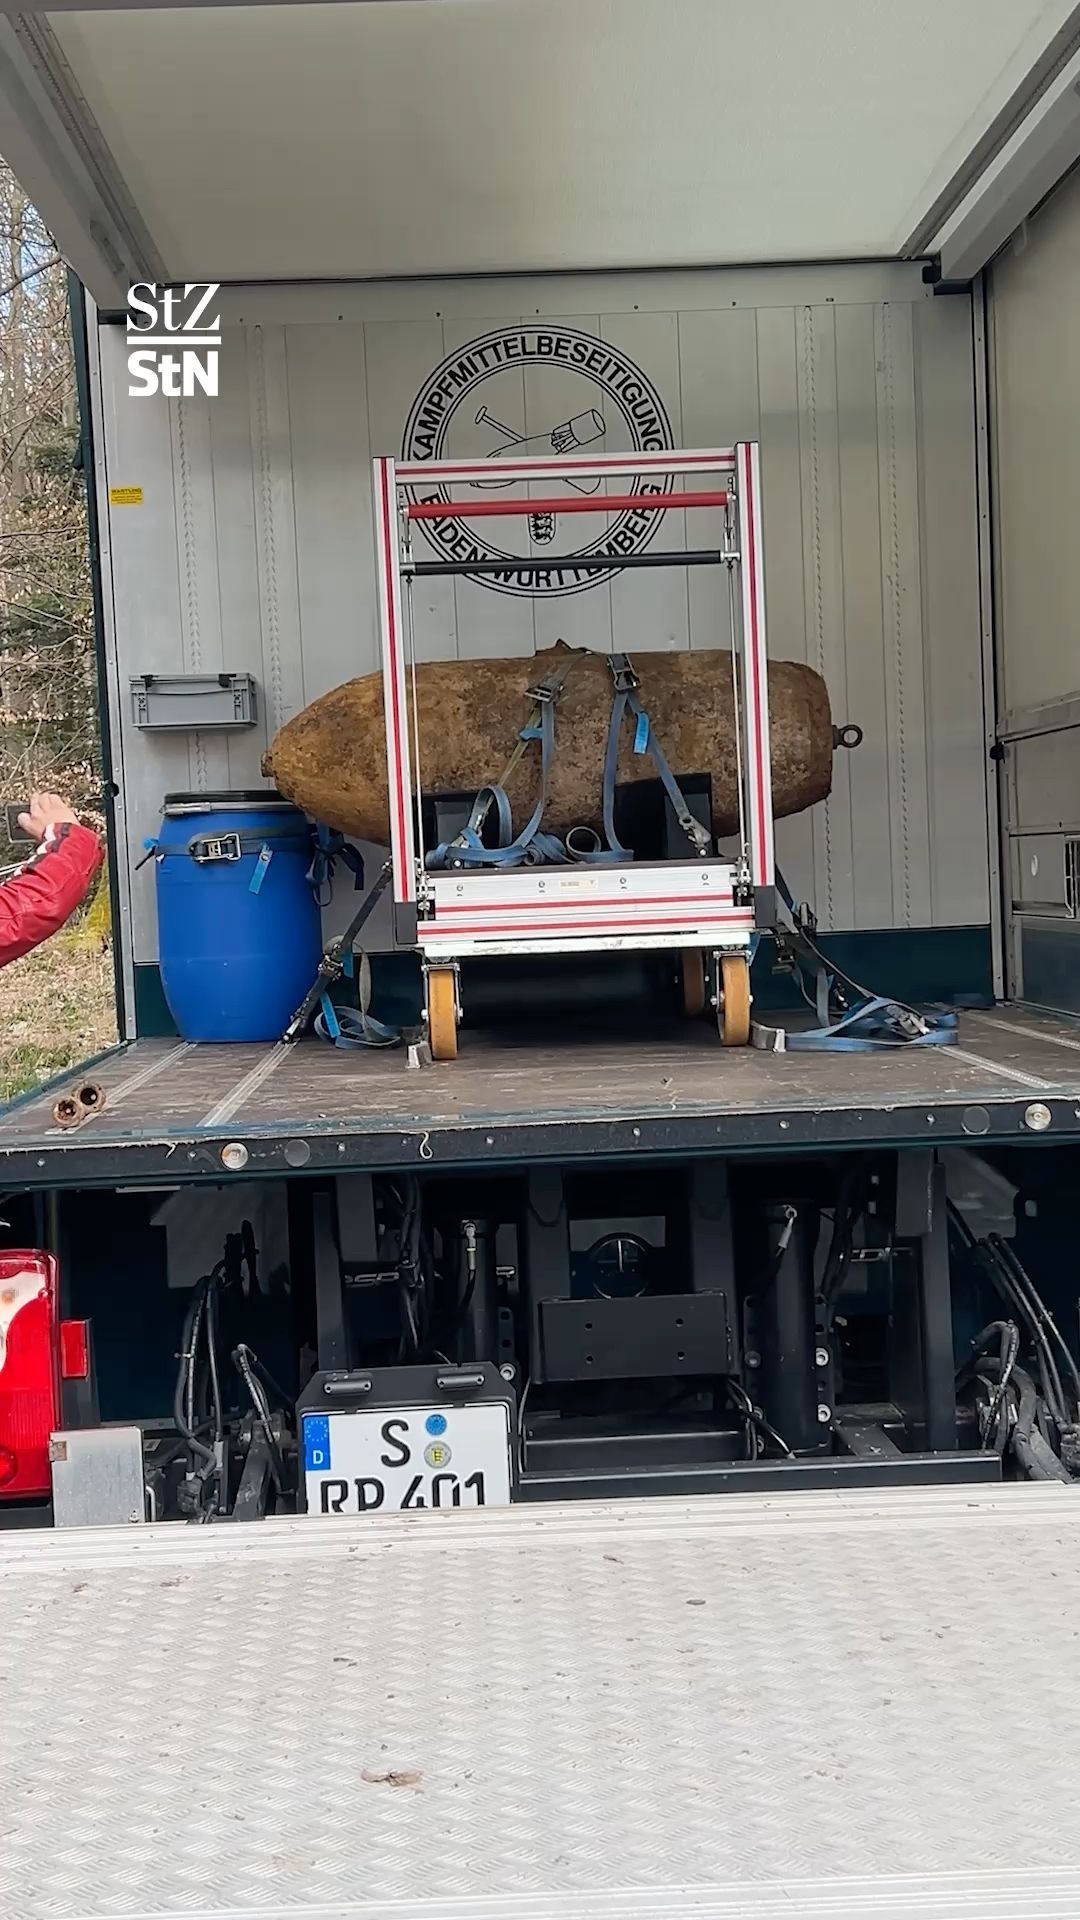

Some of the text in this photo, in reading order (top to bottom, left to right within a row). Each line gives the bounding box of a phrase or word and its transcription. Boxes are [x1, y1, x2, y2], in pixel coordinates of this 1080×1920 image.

[412, 335, 664, 460] KAMPFMITTELBESEITIGUNG
[312, 1450, 324, 1465] D
[380, 1419, 411, 1468] S
[400, 1471, 486, 1510] 401
